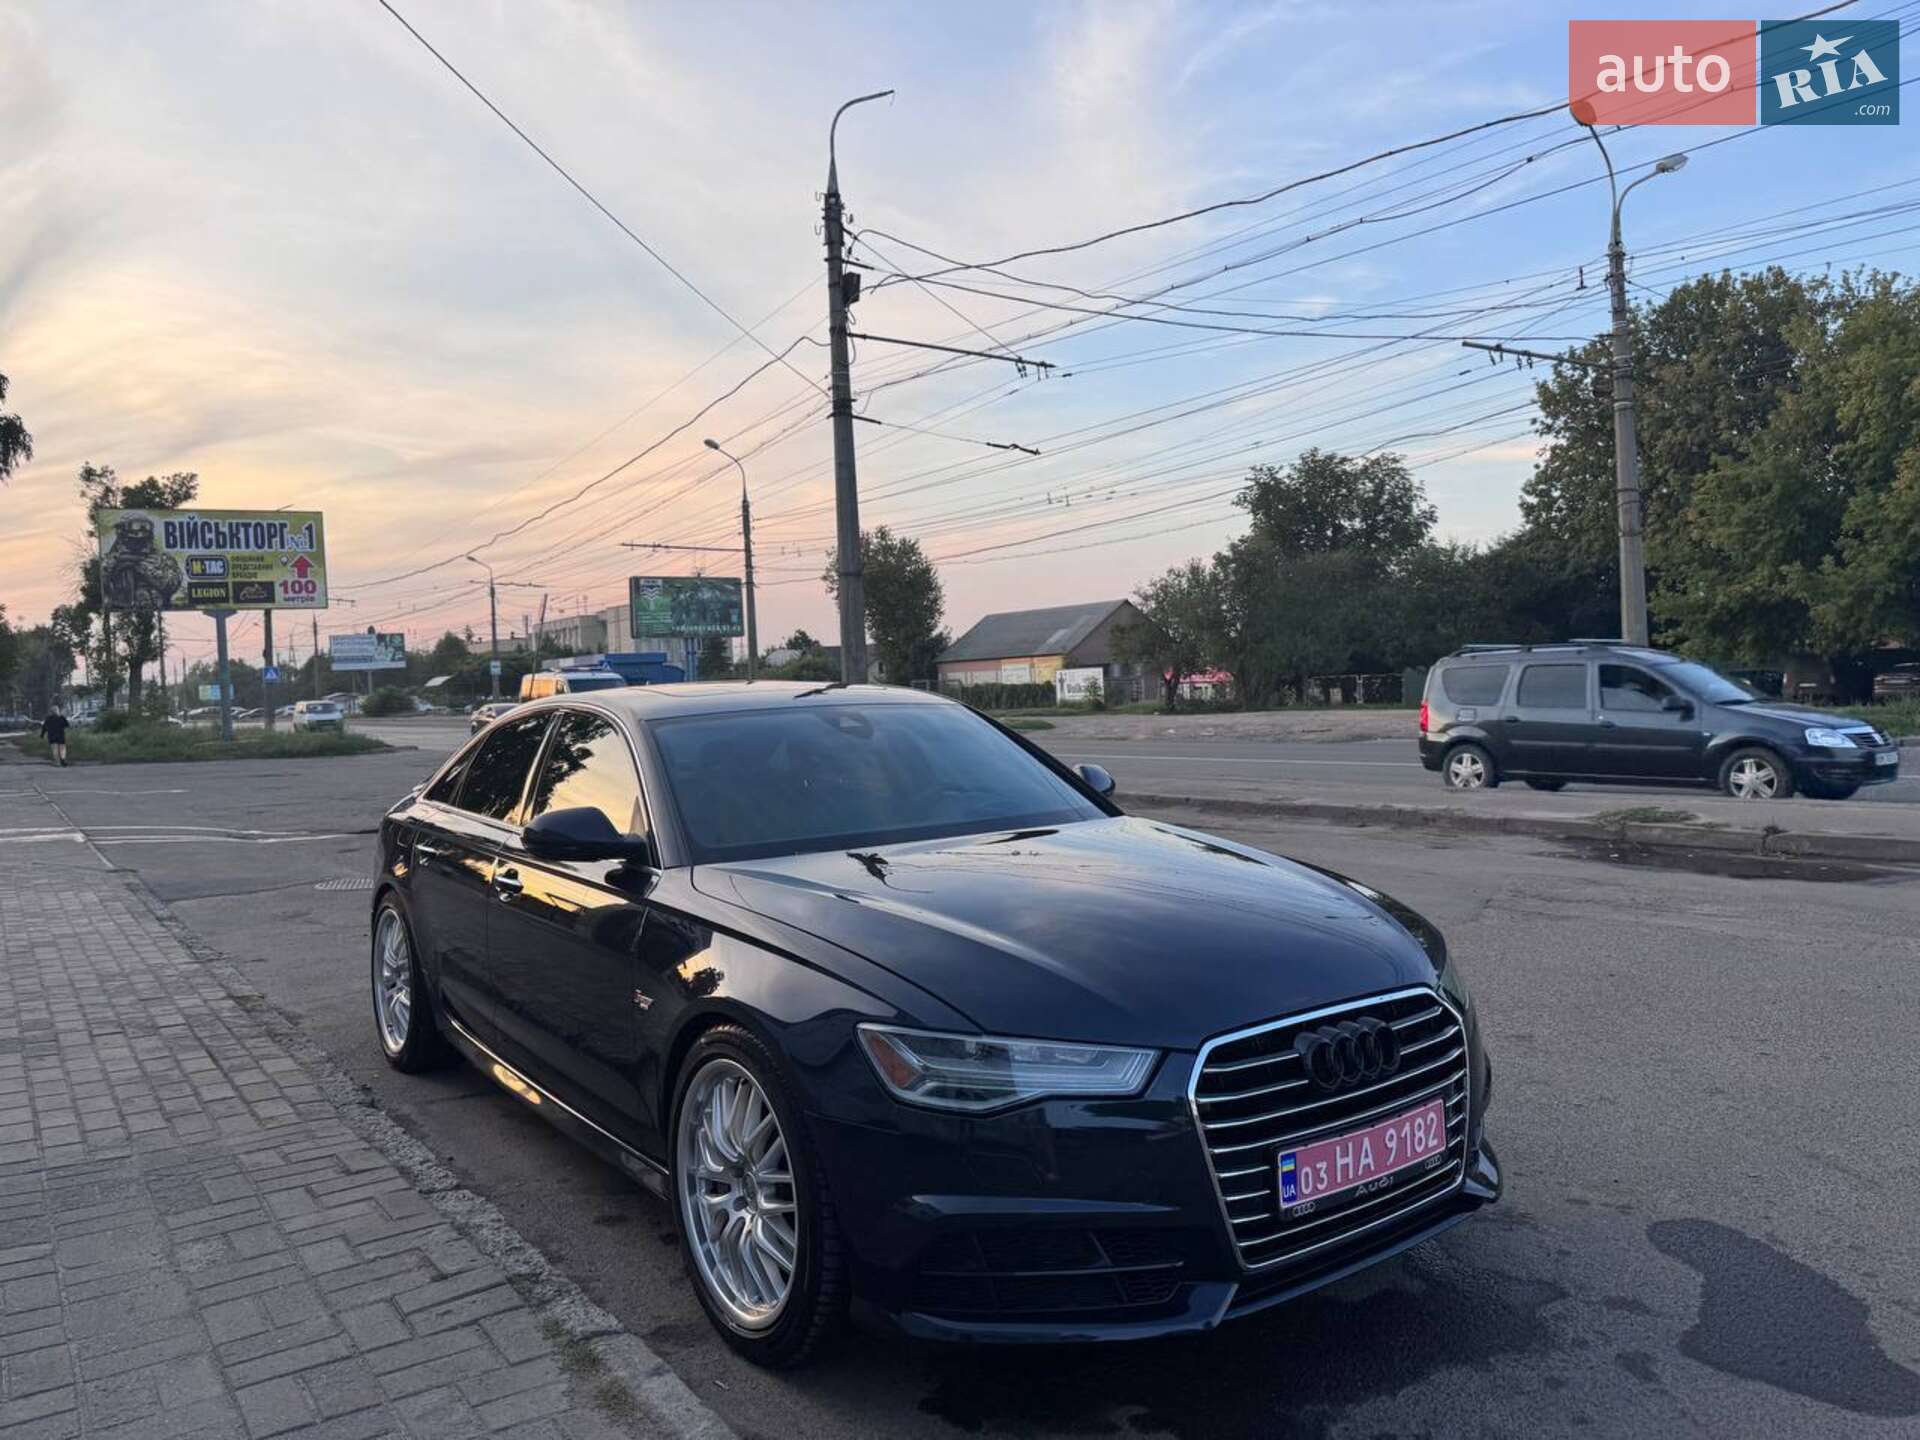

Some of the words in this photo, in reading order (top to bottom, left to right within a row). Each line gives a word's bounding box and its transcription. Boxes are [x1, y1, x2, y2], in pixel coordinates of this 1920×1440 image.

[164, 516, 288, 549] ВІЙСЬКТОРГ
[192, 588, 226, 598] LEGION
[279, 580, 317, 595] 100
[1300, 1161, 1328, 1194] 03
[1385, 1112, 1438, 1166] 9182
[1283, 1187, 1296, 1199] UA
[1355, 1176, 1394, 1197] Audi
